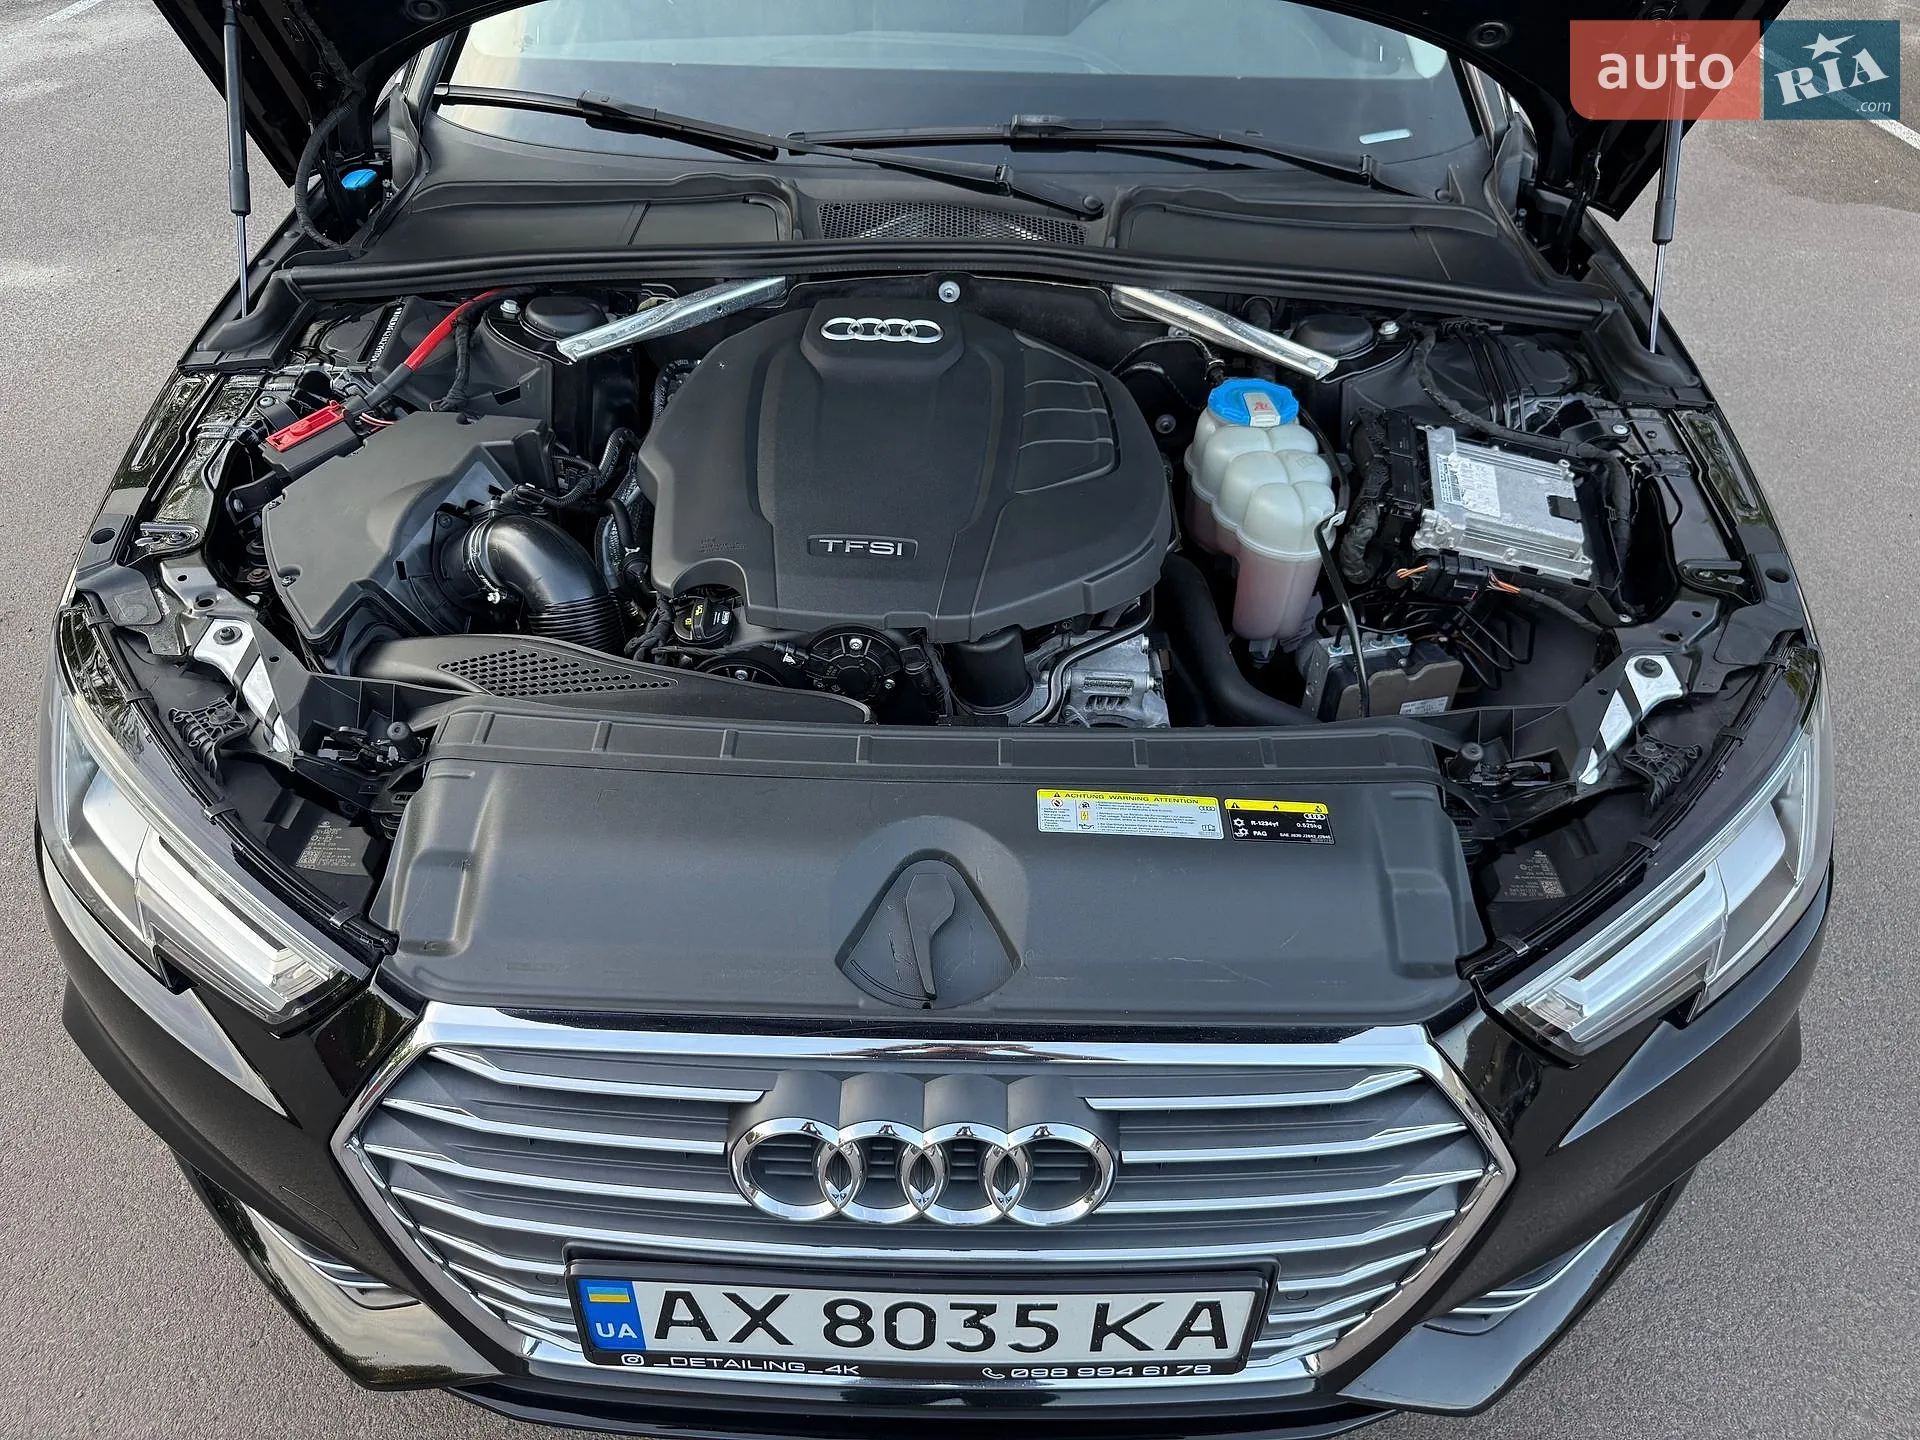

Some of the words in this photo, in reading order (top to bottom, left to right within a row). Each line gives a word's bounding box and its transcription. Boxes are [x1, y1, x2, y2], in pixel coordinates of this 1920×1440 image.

[818, 539, 903, 556] TFSI
[1153, 796, 1199, 804] ATTENTION
[654, 1290, 794, 1346] AX
[822, 1297, 1059, 1353] 8035
[1089, 1299, 1229, 1352] KA
[596, 1322, 638, 1339] UA
[1011, 1367, 1069, 1379] 098
[1077, 1366, 1134, 1378] 994
